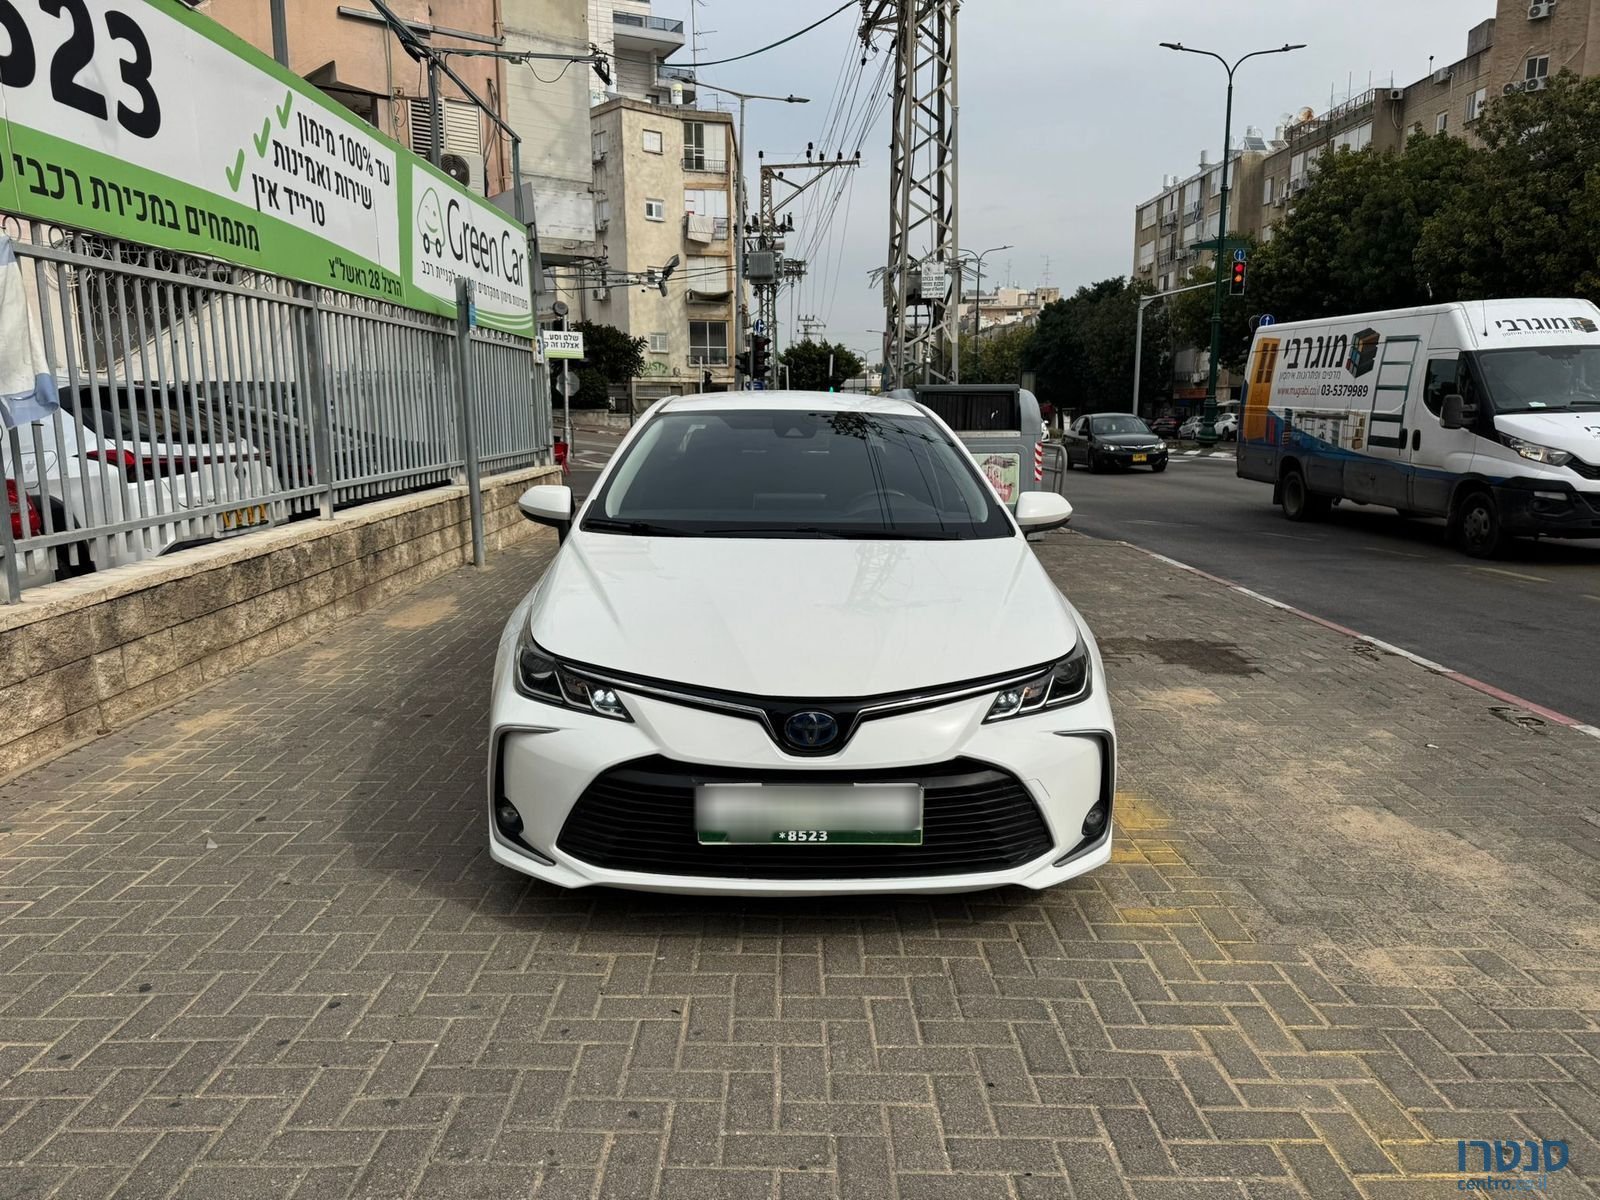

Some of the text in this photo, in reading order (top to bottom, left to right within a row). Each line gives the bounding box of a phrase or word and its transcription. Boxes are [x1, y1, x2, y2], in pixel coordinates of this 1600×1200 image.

[297, 112, 390, 186] עד 100% מימון
[13, 153, 83, 205] רכבי
[272, 139, 372, 209] שירות ואמינות
[90, 176, 181, 231] במכירת
[252, 173, 325, 227] טרייד אין
[186, 209, 260, 252] מתמחים
[447, 198, 523, 287] Green Car
[368, 268, 380, 291] 28
[381, 273, 402, 297] הרצל
[421, 260, 435, 276] רכב
[436, 267, 456, 286] לקניית
[1495, 317, 1570, 331] מוגרבי
[550, 341, 558, 349] זה
[1283, 334, 1347, 369] מוגרבי
[1321, 384, 1369, 397] 03-5379989
